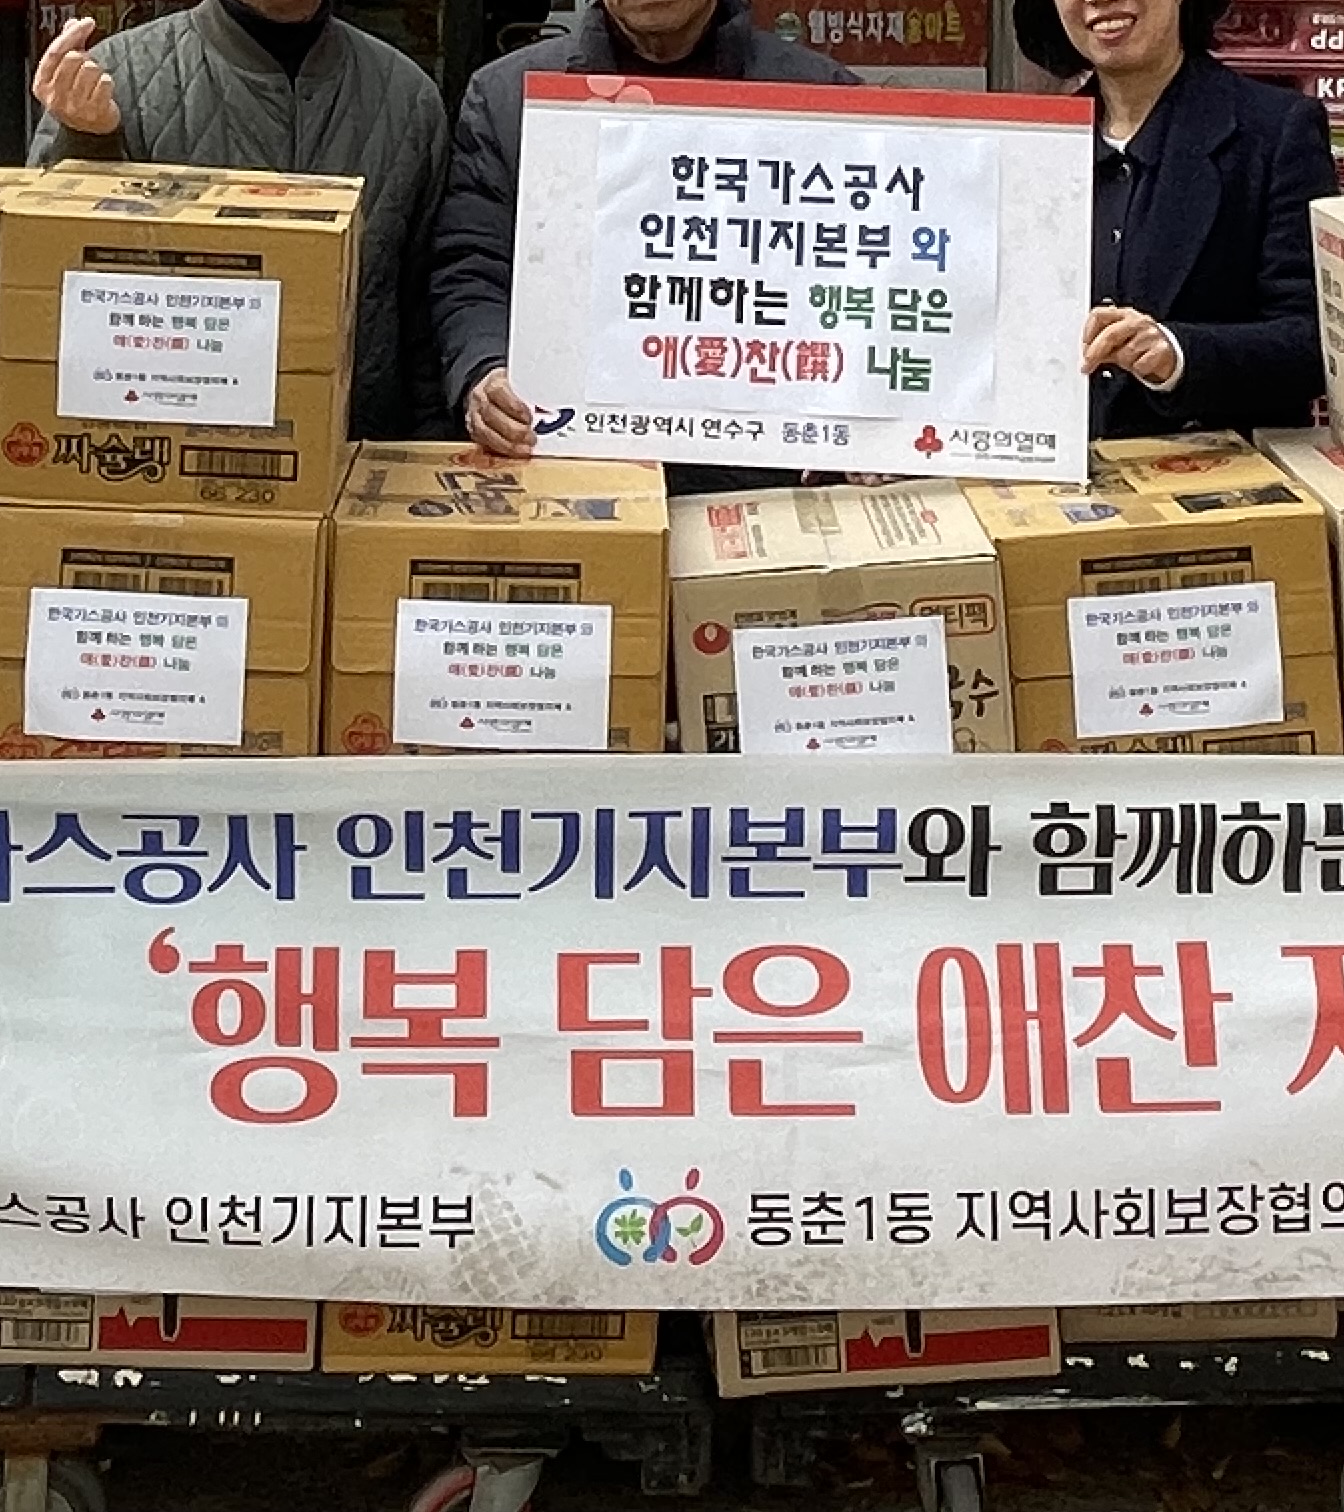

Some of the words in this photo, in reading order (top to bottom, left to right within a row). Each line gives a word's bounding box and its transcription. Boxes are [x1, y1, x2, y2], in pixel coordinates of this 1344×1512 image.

[671, 154, 925, 210] 한국가스공사
[639, 213, 891, 267] 인천기지본부
[911, 226, 951, 272] 와
[623, 273, 788, 326] 함께하는
[808, 284, 874, 330] 행복
[887, 286, 953, 334] 담은
[866, 344, 932, 393] 나눔
[584, 412, 695, 439] 인천광역시
[701, 417, 766, 440] 연수구
[335, 805, 1003, 899] 인천기지본부와
[556, 944, 864, 1118] 담은
[915, 940, 1234, 1116] 애찬
[166, 1191, 476, 1249] 인천기지본부
[746, 1189, 934, 1248] 동춘1동
